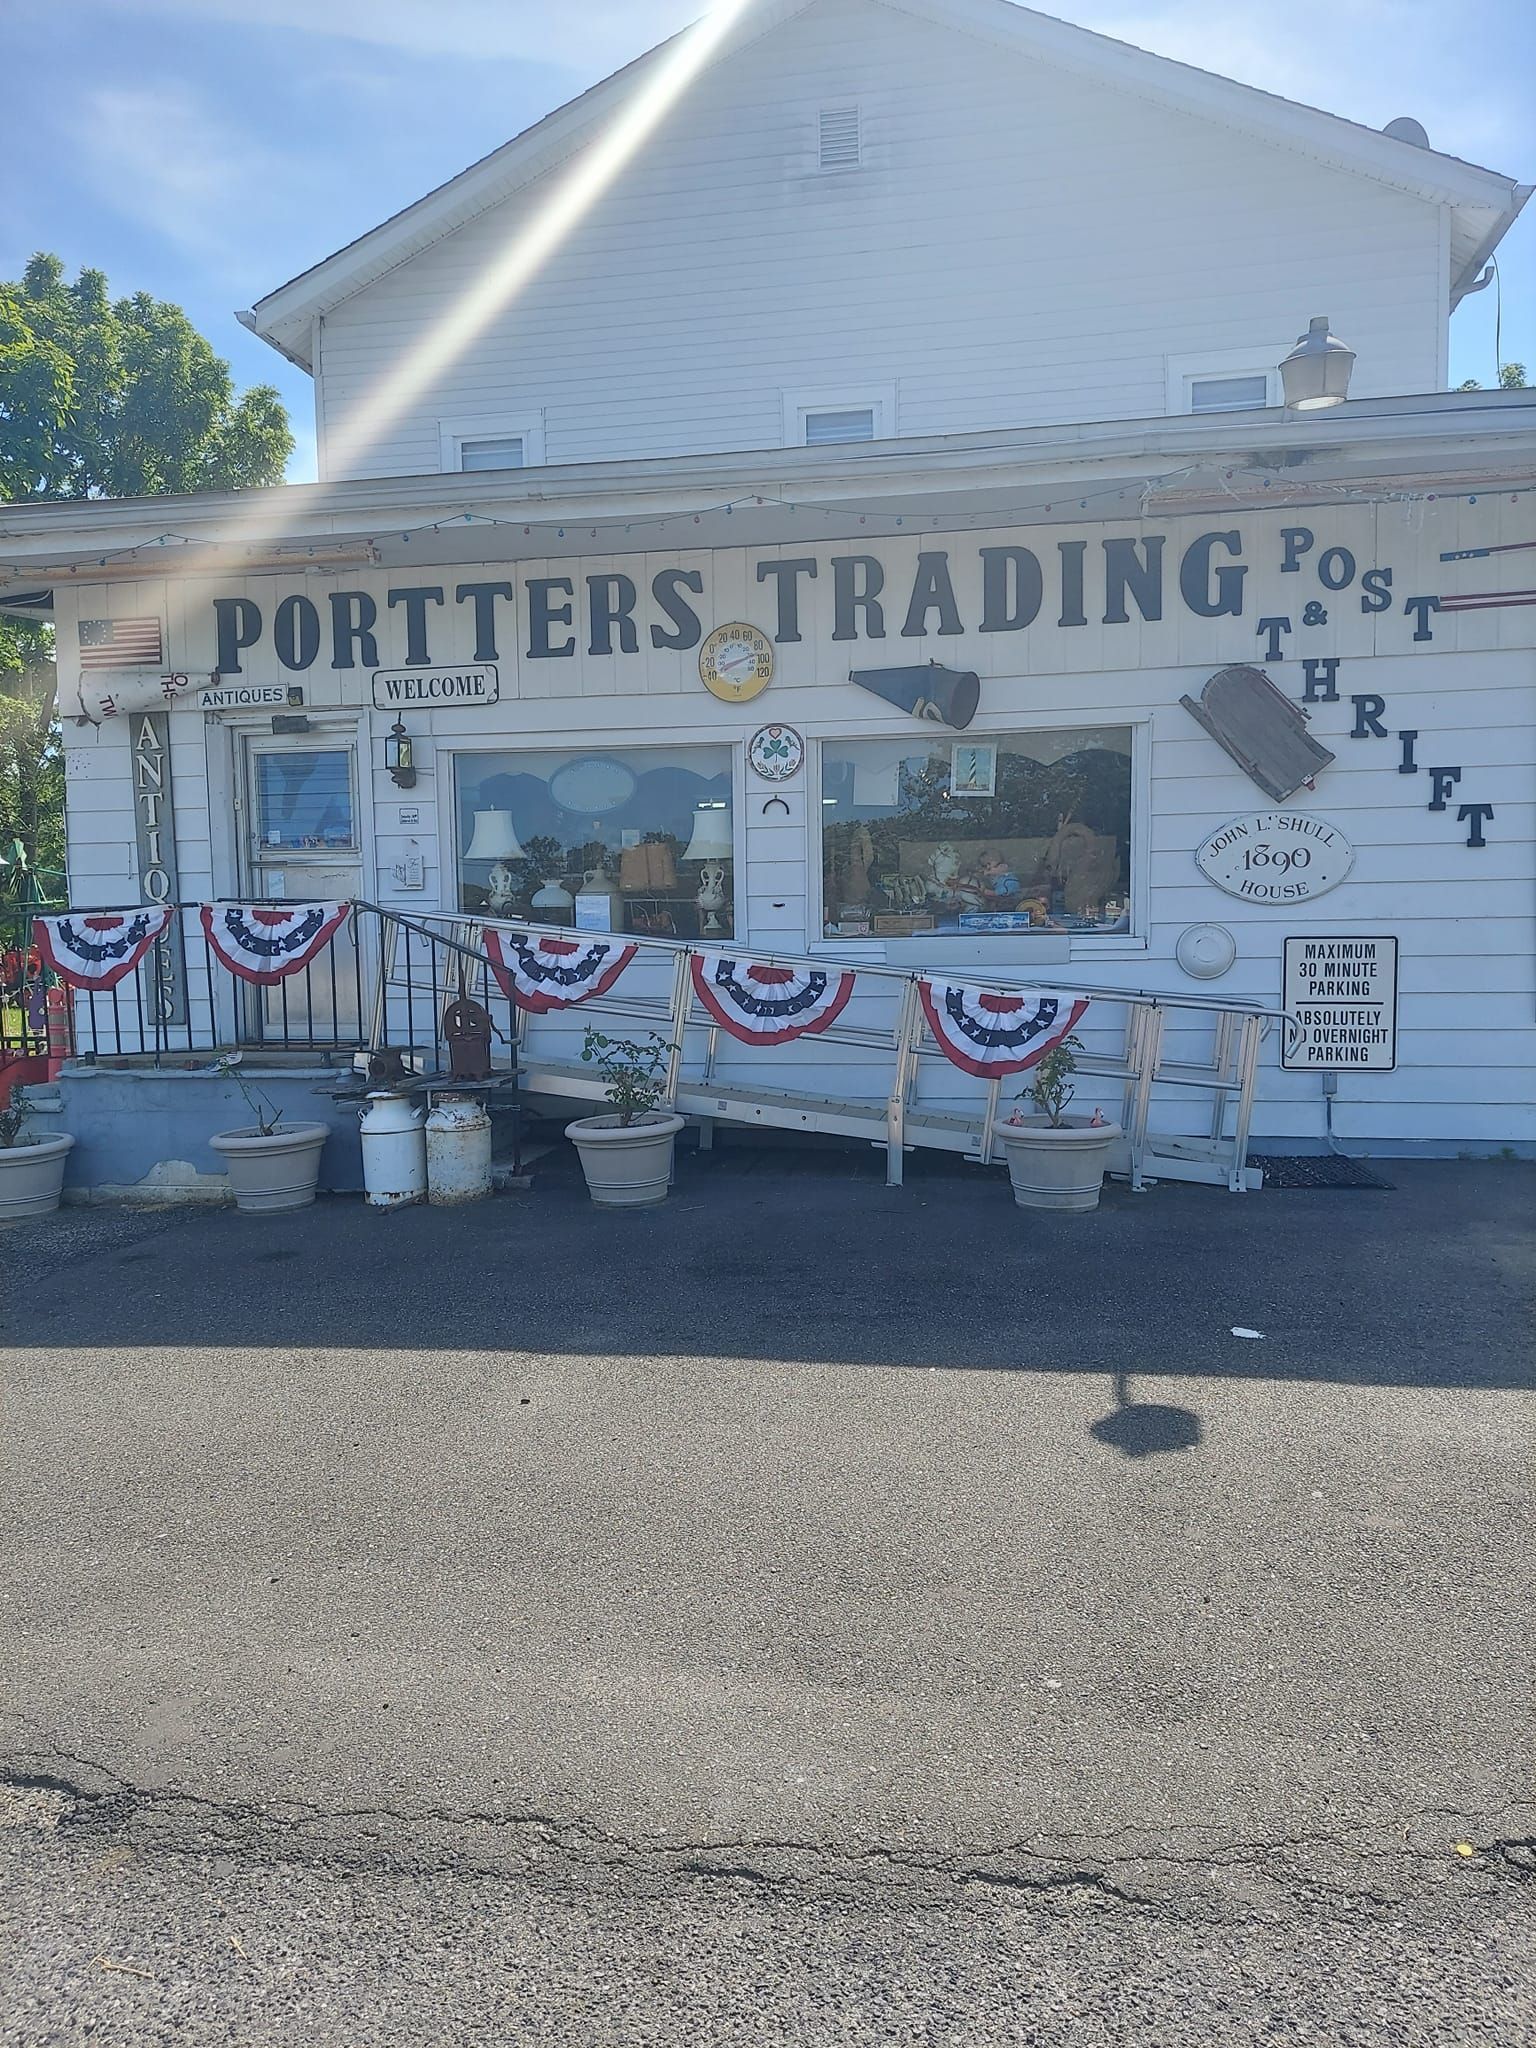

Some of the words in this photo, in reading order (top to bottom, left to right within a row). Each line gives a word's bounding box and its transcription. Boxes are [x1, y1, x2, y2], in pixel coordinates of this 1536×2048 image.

[213, 569, 703, 674] PORTTERS
[757, 530, 1248, 643] TRADING
[1281, 527, 1441, 641] POST
[1303, 601, 1328, 626] &
[719, 632, 728, 643] 20
[730, 629, 740, 640] 40
[742, 630, 753, 641] 60
[757, 652, 770, 664] 100
[757, 667, 770, 678] 120
[385, 675, 485, 700] WELCOME
[202, 687, 284, 706] ANTIQUES
[1256, 617, 1495, 847] THRIFT
[1210, 823, 1249, 858] JOHN
[1278, 817, 1336, 848] SHULL
[1242, 844, 1311, 876] 1890
[1240, 879, 1309, 899] HOUSE
[1305, 944, 1376, 959] MAXIMUM
[1299, 962, 1317, 977] 30
[1324, 962, 1378, 977] MINUTE
[1309, 981, 1370, 996] PARKING
[1296, 1010, 1381, 1026] ABSOLUTELY
[1313, 1028, 1389, 1044] OVERNIGHT
[1308, 1046, 1369, 1062] PARKING
